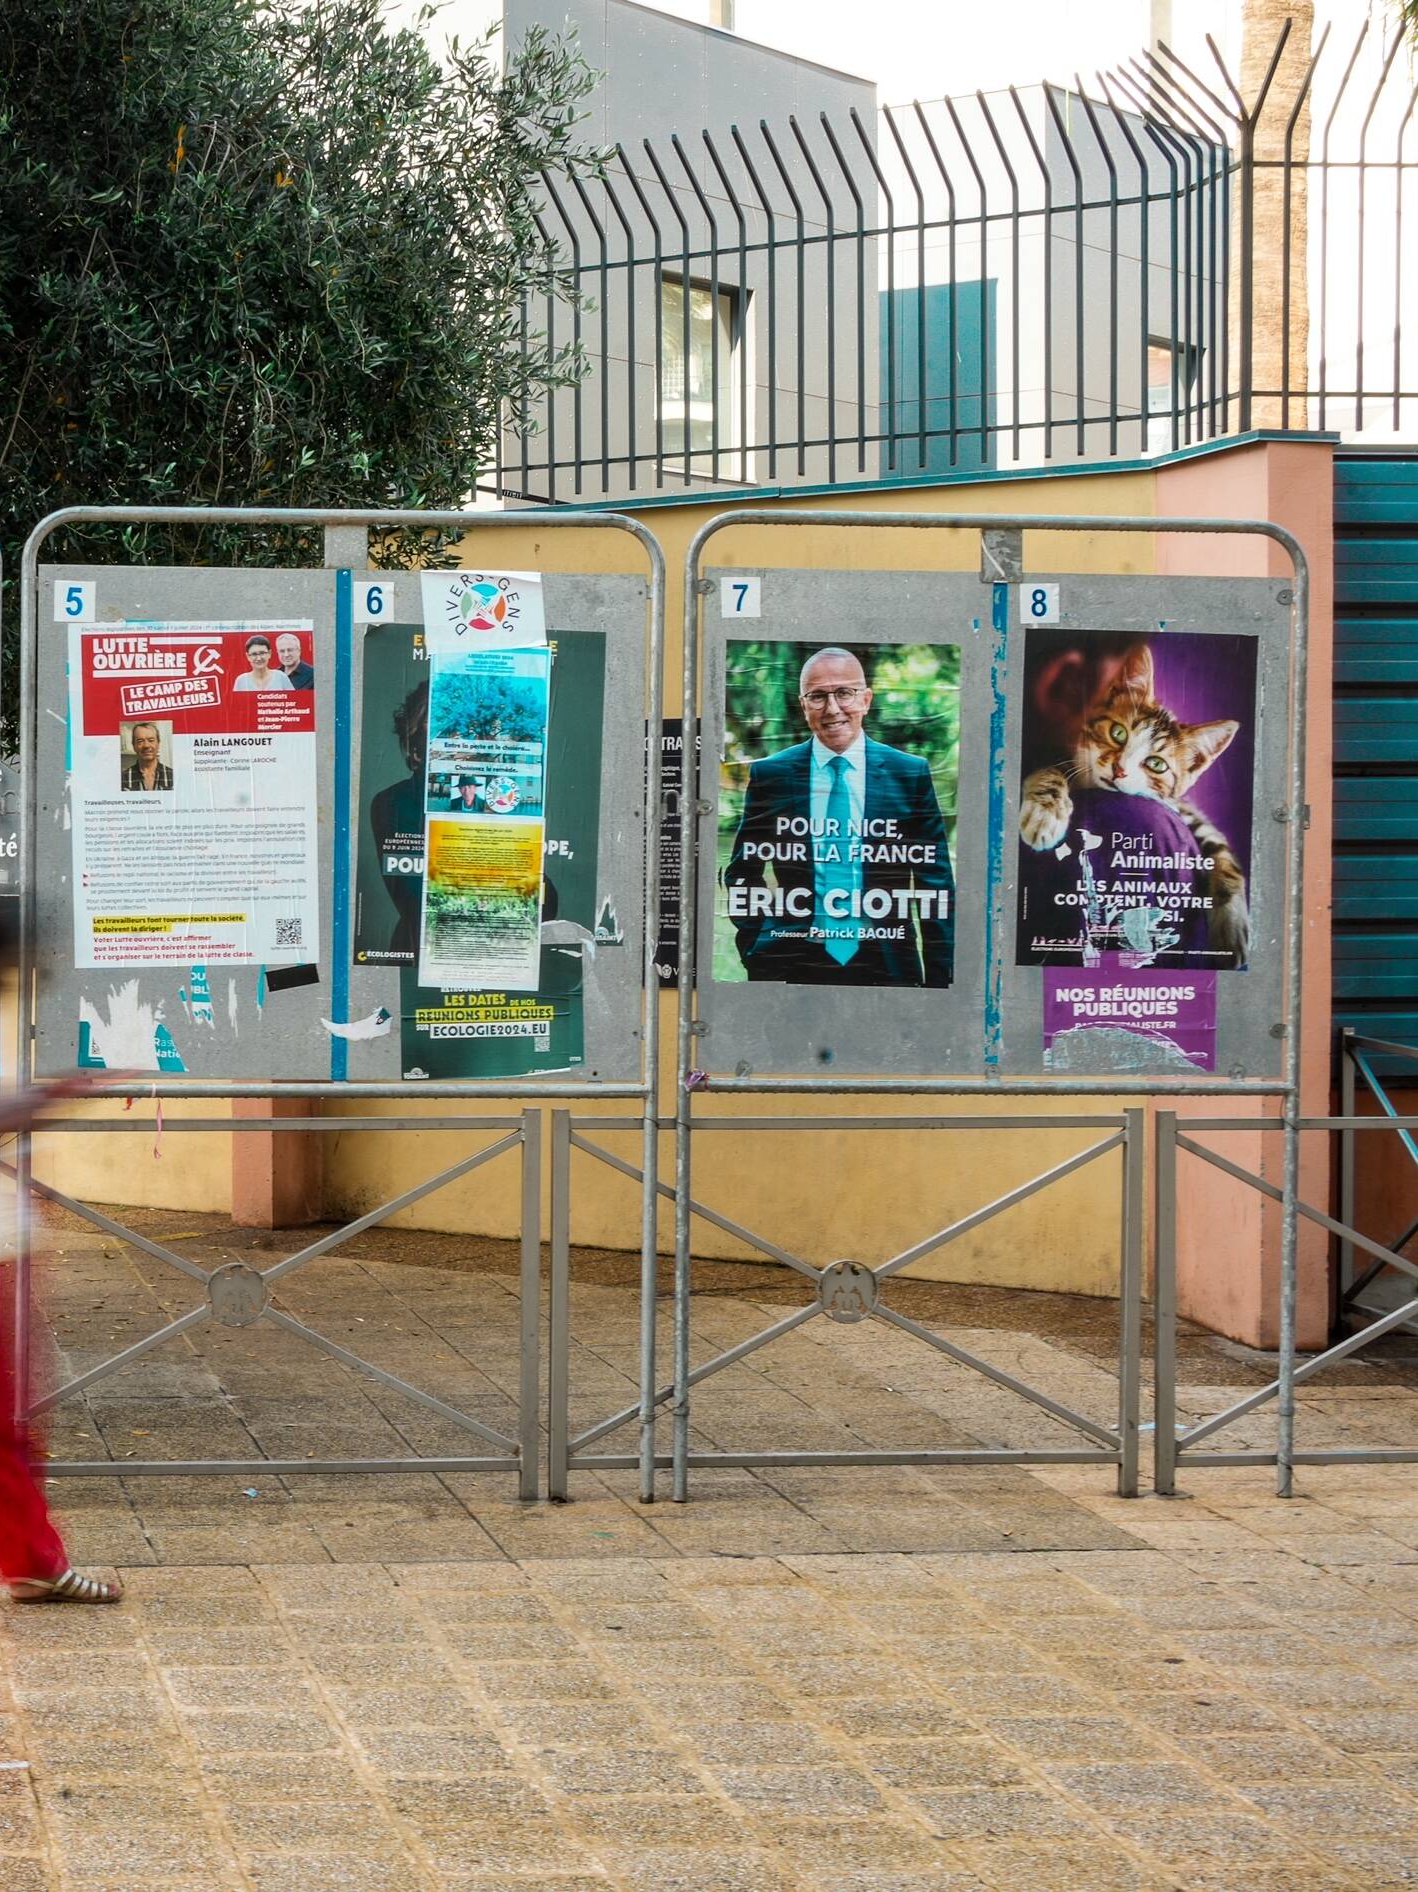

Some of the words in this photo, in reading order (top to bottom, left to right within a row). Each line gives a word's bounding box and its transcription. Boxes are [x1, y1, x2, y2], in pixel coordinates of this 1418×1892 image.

[66, 587, 83, 616] 5
[366, 586, 383, 615] 6
[446, 574, 520, 636] DIVERS-GENS
[732, 584, 748, 612] 7
[1030, 589, 1048, 617] 8
[92, 637, 148, 654] LUTTE
[93, 648, 187, 670] OUVRIÈRE
[129, 687, 144, 699] LE
[145, 683, 183, 697] CAMP
[184, 679, 208, 692] DES
[126, 691, 215, 713] TRAVAILLEURS
[193, 738, 220, 748] Alain
[221, 737, 272, 747] LANGOUET
[193, 749, 231, 758] Enseignant
[776, 816, 839, 837] POUR
[846, 818, 903, 839] NICE,
[1111, 831, 1153, 850] Parti
[743, 842, 806, 862] POUR
[813, 842, 842, 863] LA
[849, 844, 936, 864] FRANCE
[1110, 851, 1215, 871] Animaliste
[386, 857, 424, 874] POU
[1111, 881, 1192, 894] ANIMAUX
[728, 880, 812, 918] ÉRIC
[823, 888, 949, 919] CIOTTI
[1157, 896, 1213, 909] VOTRE
[105, 916, 146, 924] travailleurs
[138, 925, 163, 934] diriger
[770, 930, 809, 939] Professeur
[809, 926, 854, 939] Patrick
[857, 925, 906, 940] BAQUÉ
[162, 943, 187, 951] doivent
[444, 995, 467, 1006] LES
[468, 994, 507, 1006] DATES
[520, 998, 536, 1006] NOS
[1055, 988, 1096, 1002] NOS
[1099, 984, 1196, 1002] RÉUNIONS
[484, 1008, 552, 1021] PUBLIQUES
[1073, 1001, 1179, 1017] PUBLIQUES
[433, 1024, 547, 1037] ECOLOGIE2024.EU
